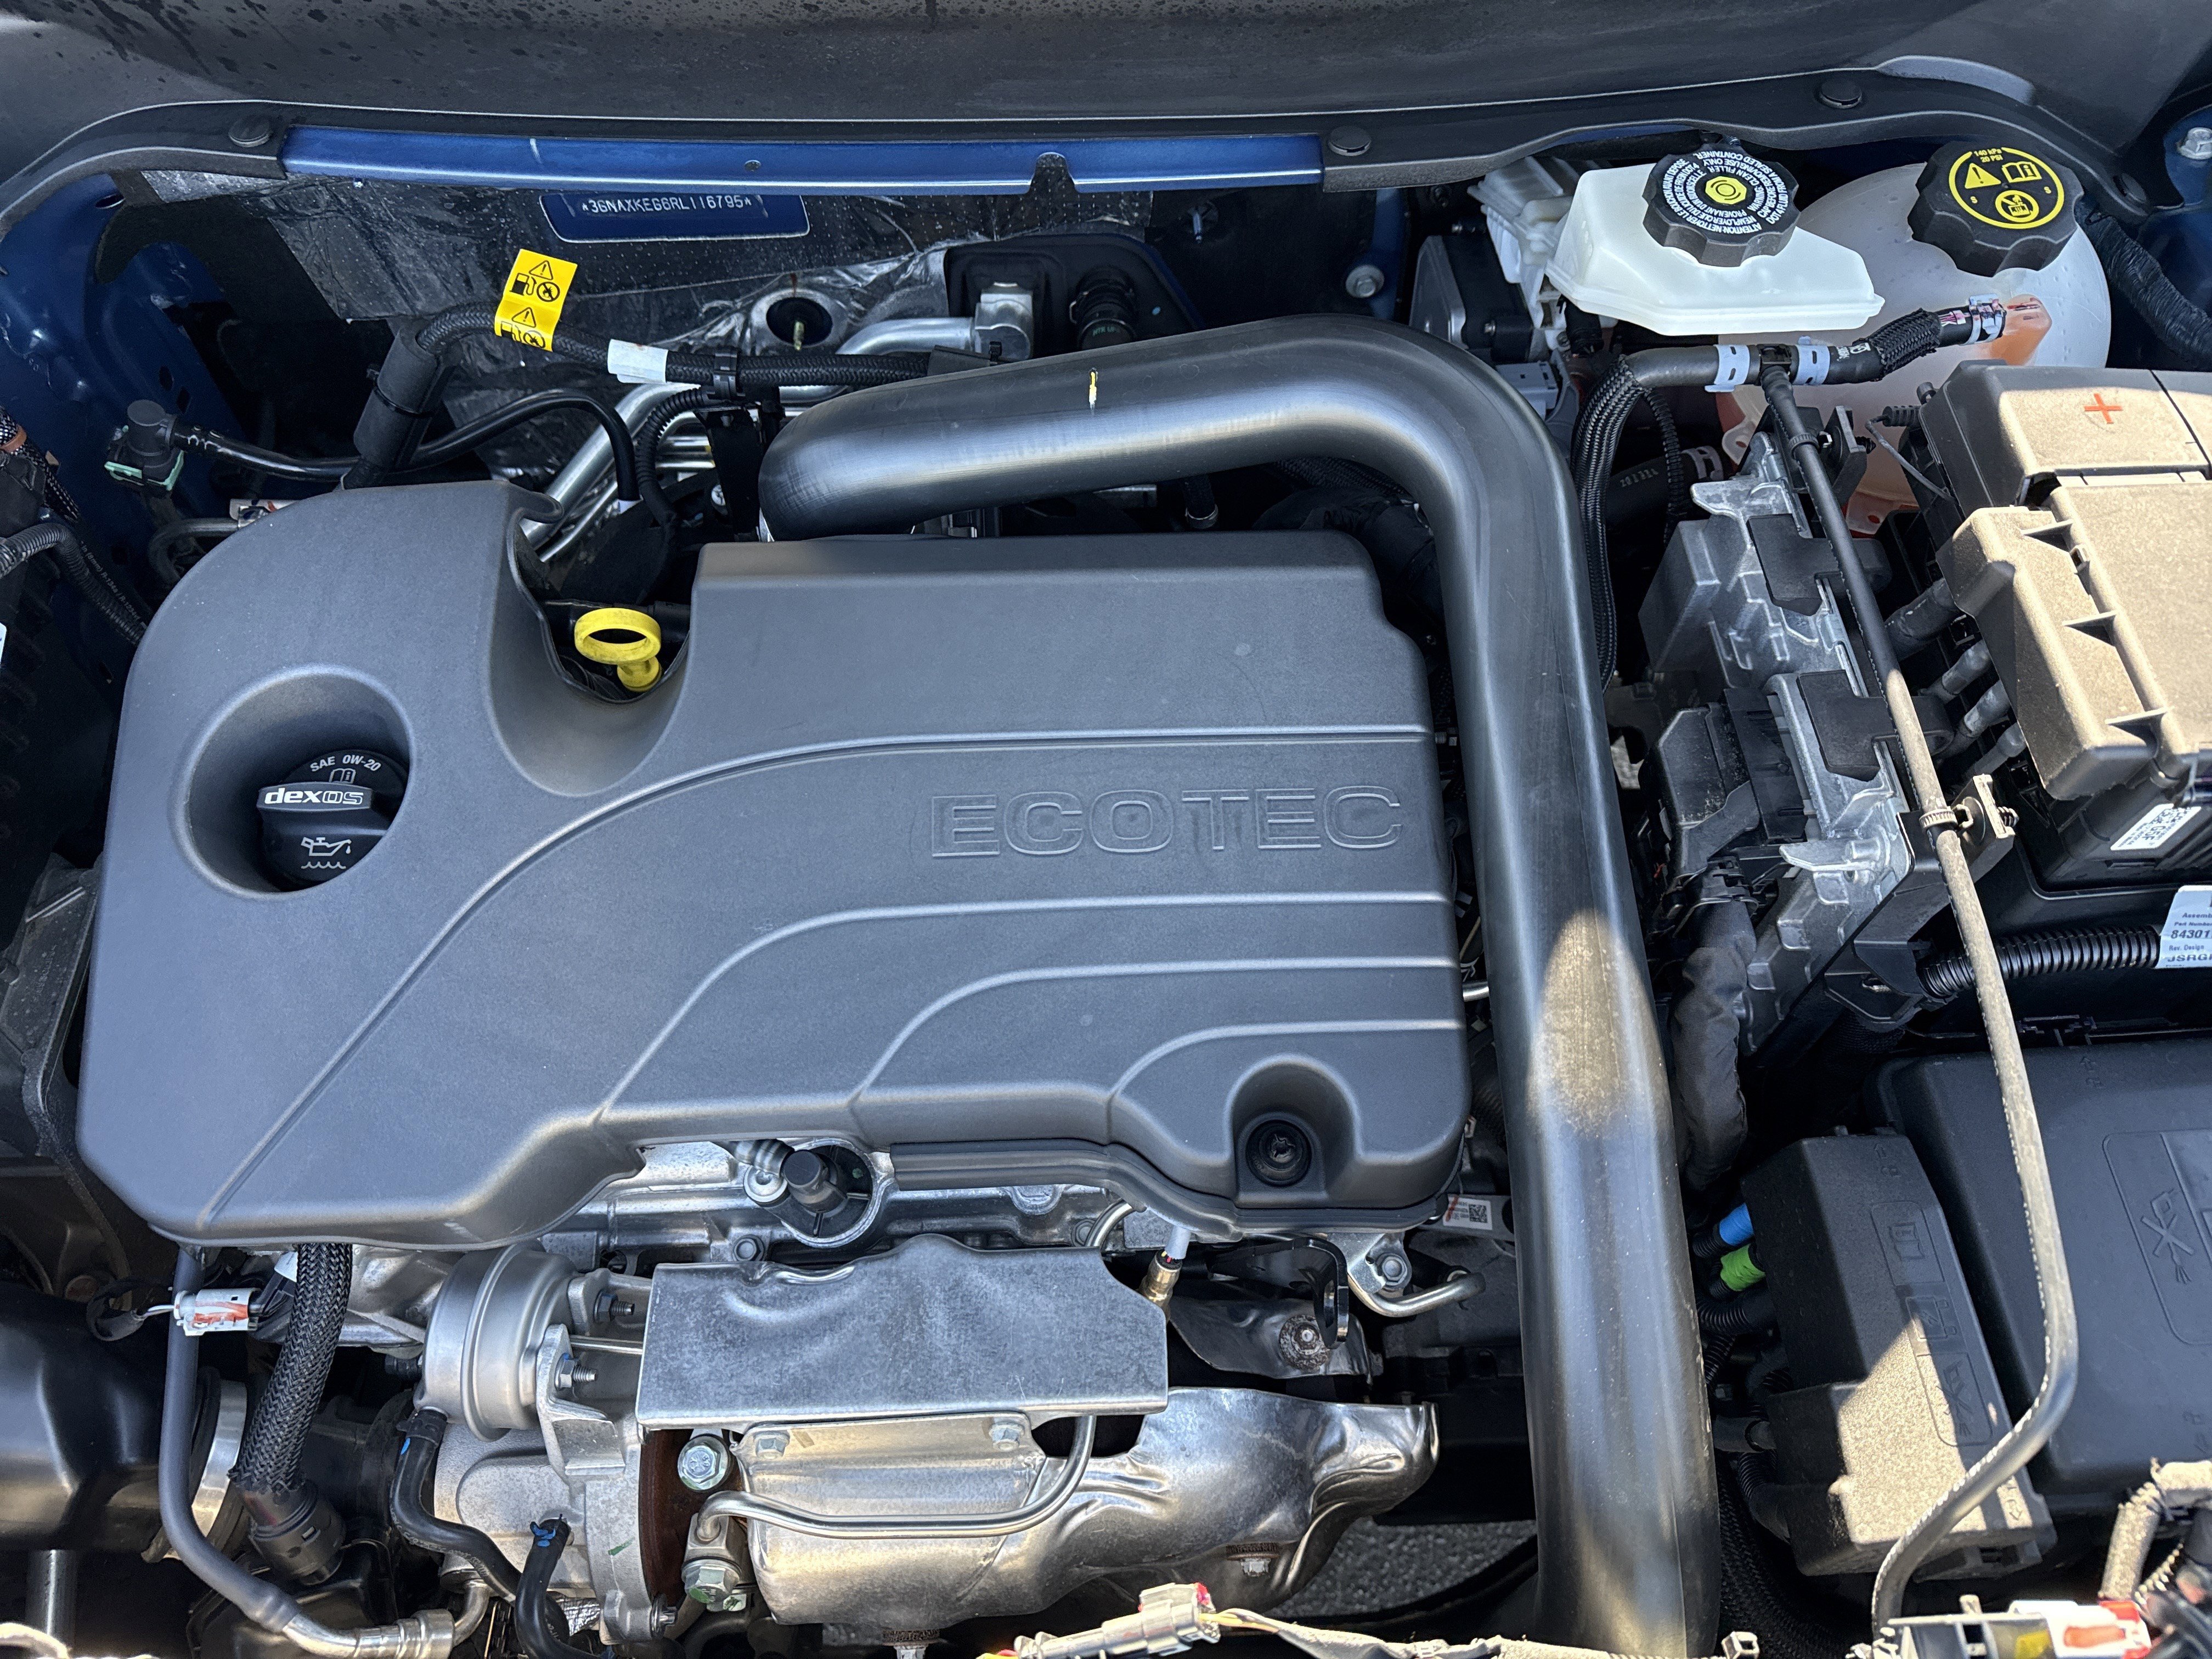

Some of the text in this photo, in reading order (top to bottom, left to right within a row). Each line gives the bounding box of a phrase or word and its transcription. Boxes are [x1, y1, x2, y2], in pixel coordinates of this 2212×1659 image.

[1681, 163, 1695, 174] DOT
[1702, 157, 1723, 166] ONLY
[1724, 158, 1740, 167] USE
[1743, 156, 1773, 174] SEALED
[1662, 173, 1674, 190] AVANT
[1674, 171, 1688, 186] FREIN
[1771, 175, 1787, 193] FROM
[1685, 185, 1698, 200] BIDON
[1707, 165, 1764, 211] WARNING: CLEAN FILLER
[1663, 189, 1683, 212] BOUCHON
[1675, 191, 1694, 210] LIQUIDE
[1764, 185, 1776, 208] BEFORE
[1776, 193, 1788, 211] FLUID
[1677, 209, 1689, 218] LE
[1688, 207, 1701, 216] DU
[1697, 211, 1713, 222] QUE
[1703, 206, 1747, 218] PROVENANT
[1757, 205, 1771, 218] CAP
[1765, 210, 1781, 224] DOT
[1686, 215, 1722, 233] NETTOYER
[310, 754, 381, 772] SAE 0W-20
[264, 787, 364, 804] dexos
[931, 785, 1402, 857] ECOTEC
[2170, 929, 2212, 939] 84301
[2167, 953, 2212, 962] JSRG
